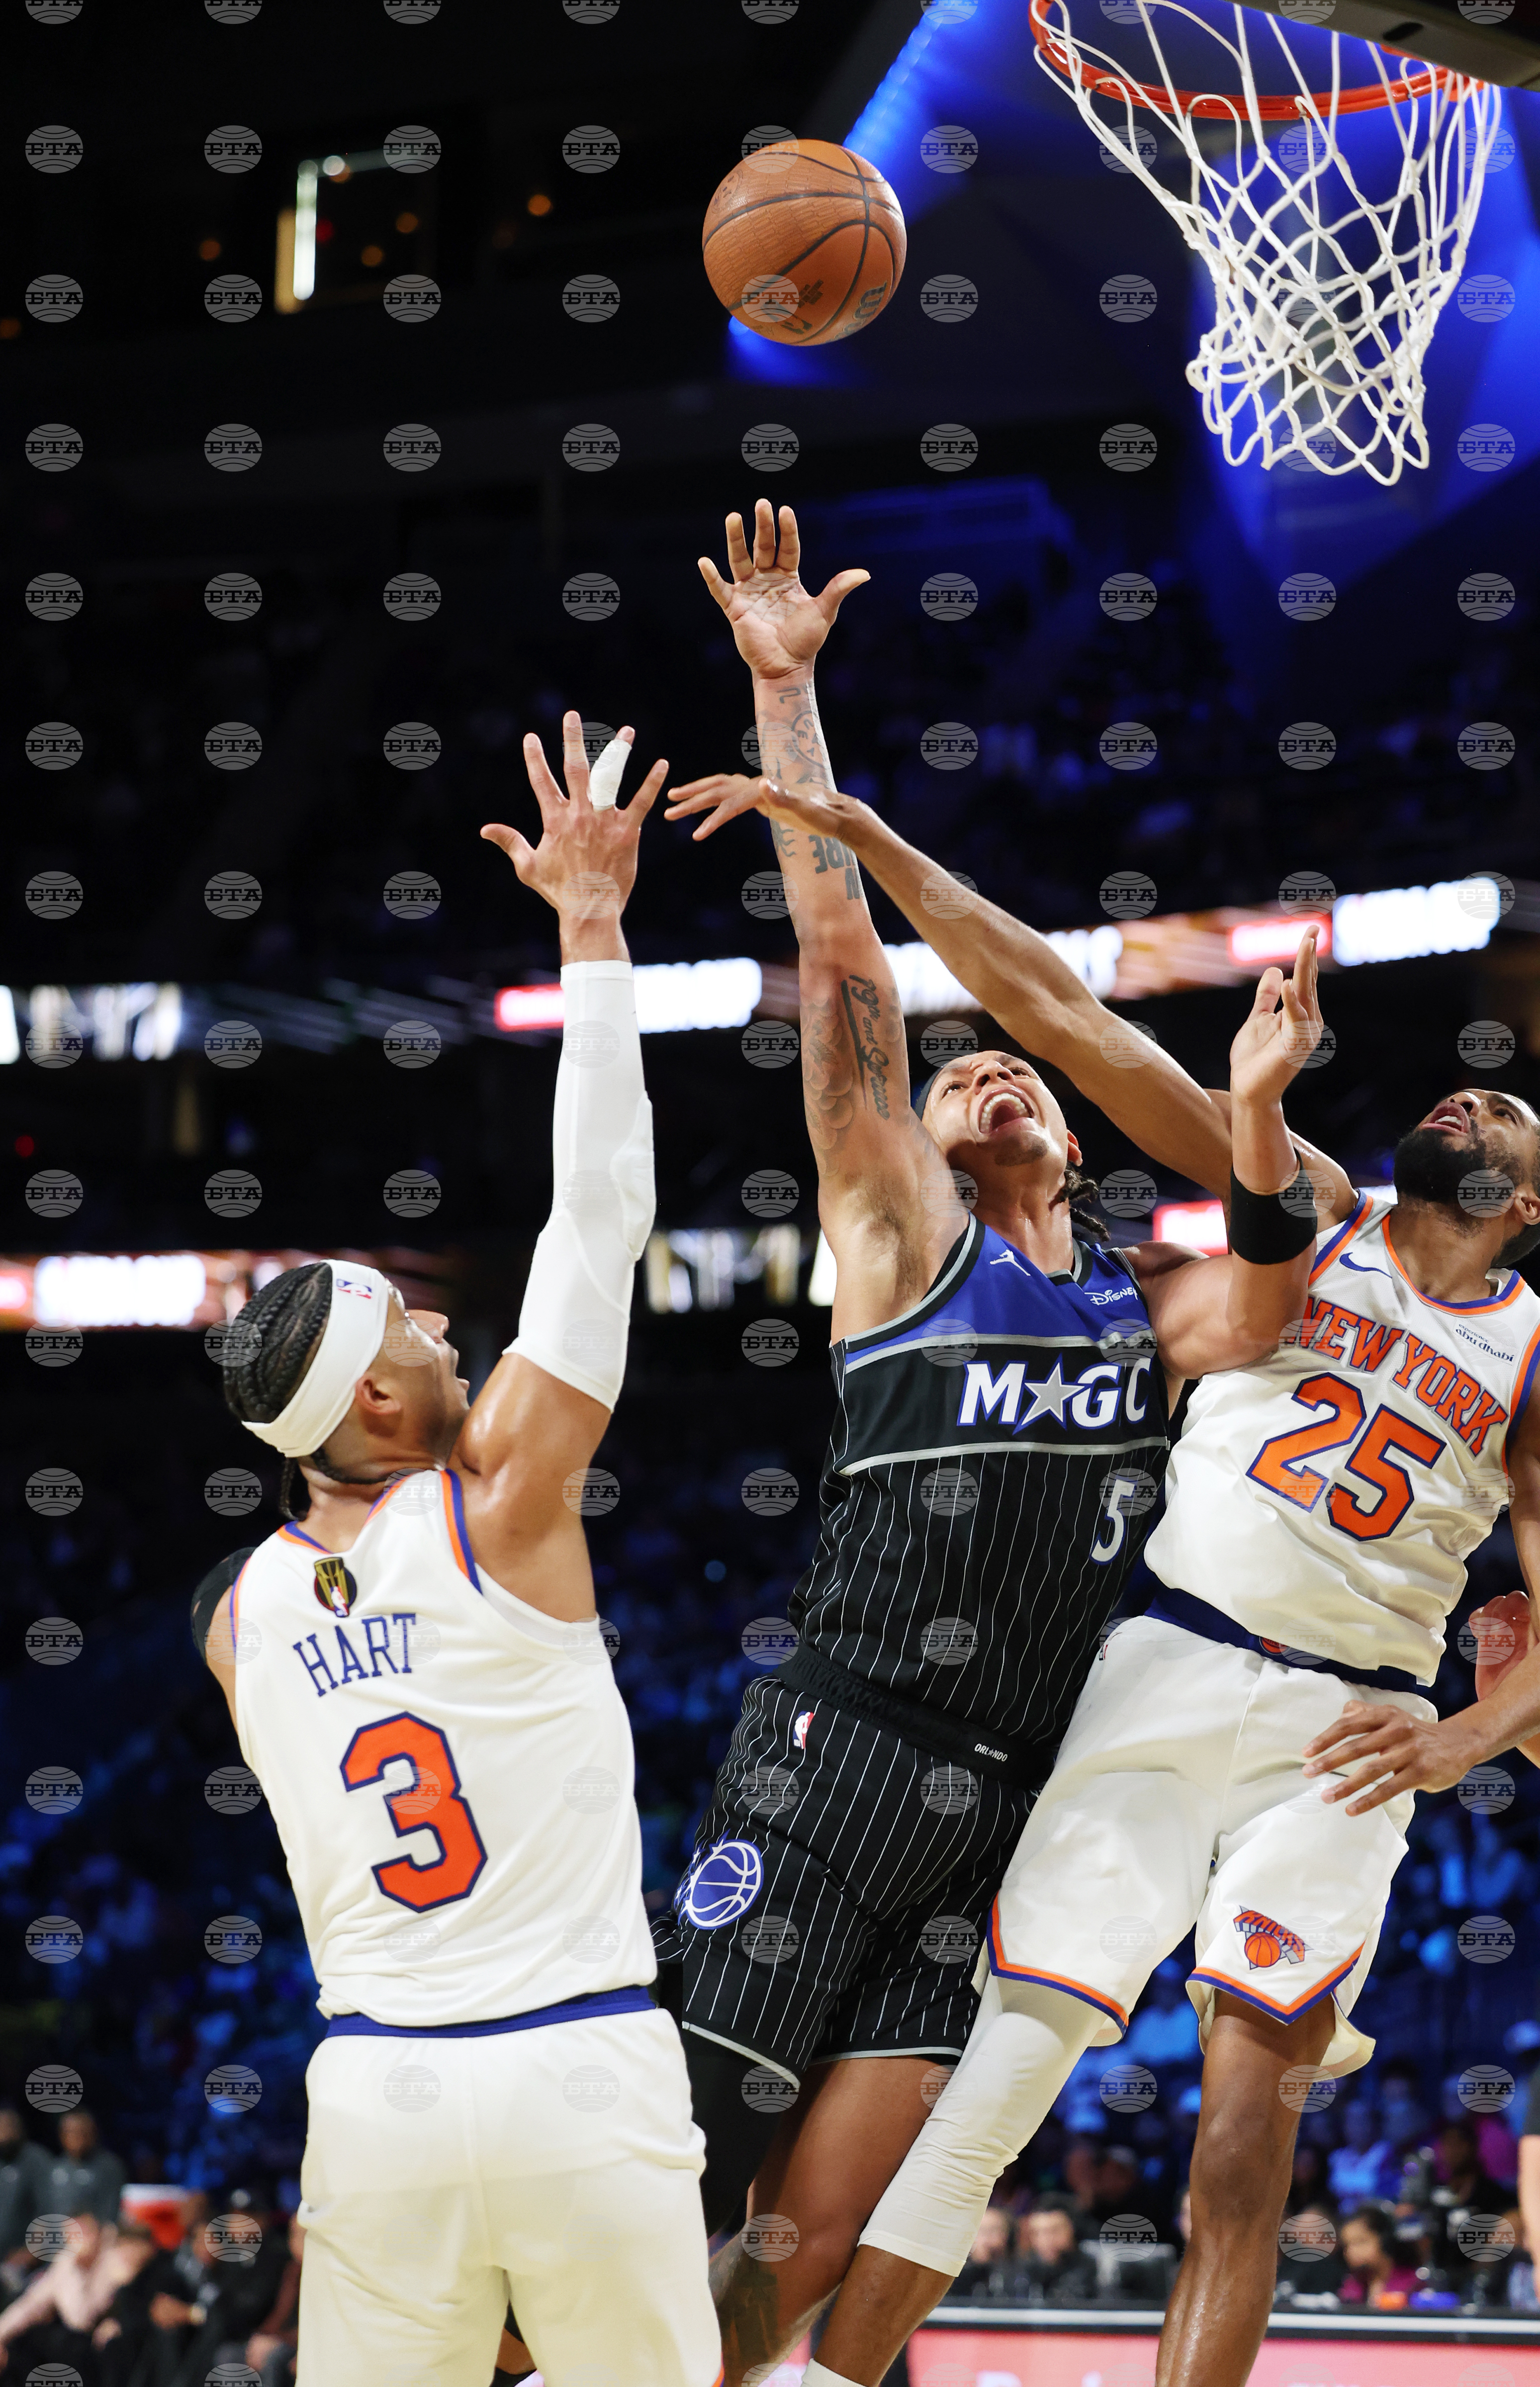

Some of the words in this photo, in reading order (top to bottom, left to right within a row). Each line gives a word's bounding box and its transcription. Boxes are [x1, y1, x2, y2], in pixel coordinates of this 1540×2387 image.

[1285, 1296, 1403, 1371] NEW
[1393, 1333, 1509, 1457] YORK
[1455, 1329, 1477, 1345] abu
[1459, 1324, 1489, 1343] experience
[1246, 1372, 1447, 1541] 25
[1089, 1475, 1139, 1565] 5
[293, 1614, 417, 1698] HART
[340, 1711, 488, 1914] 3
